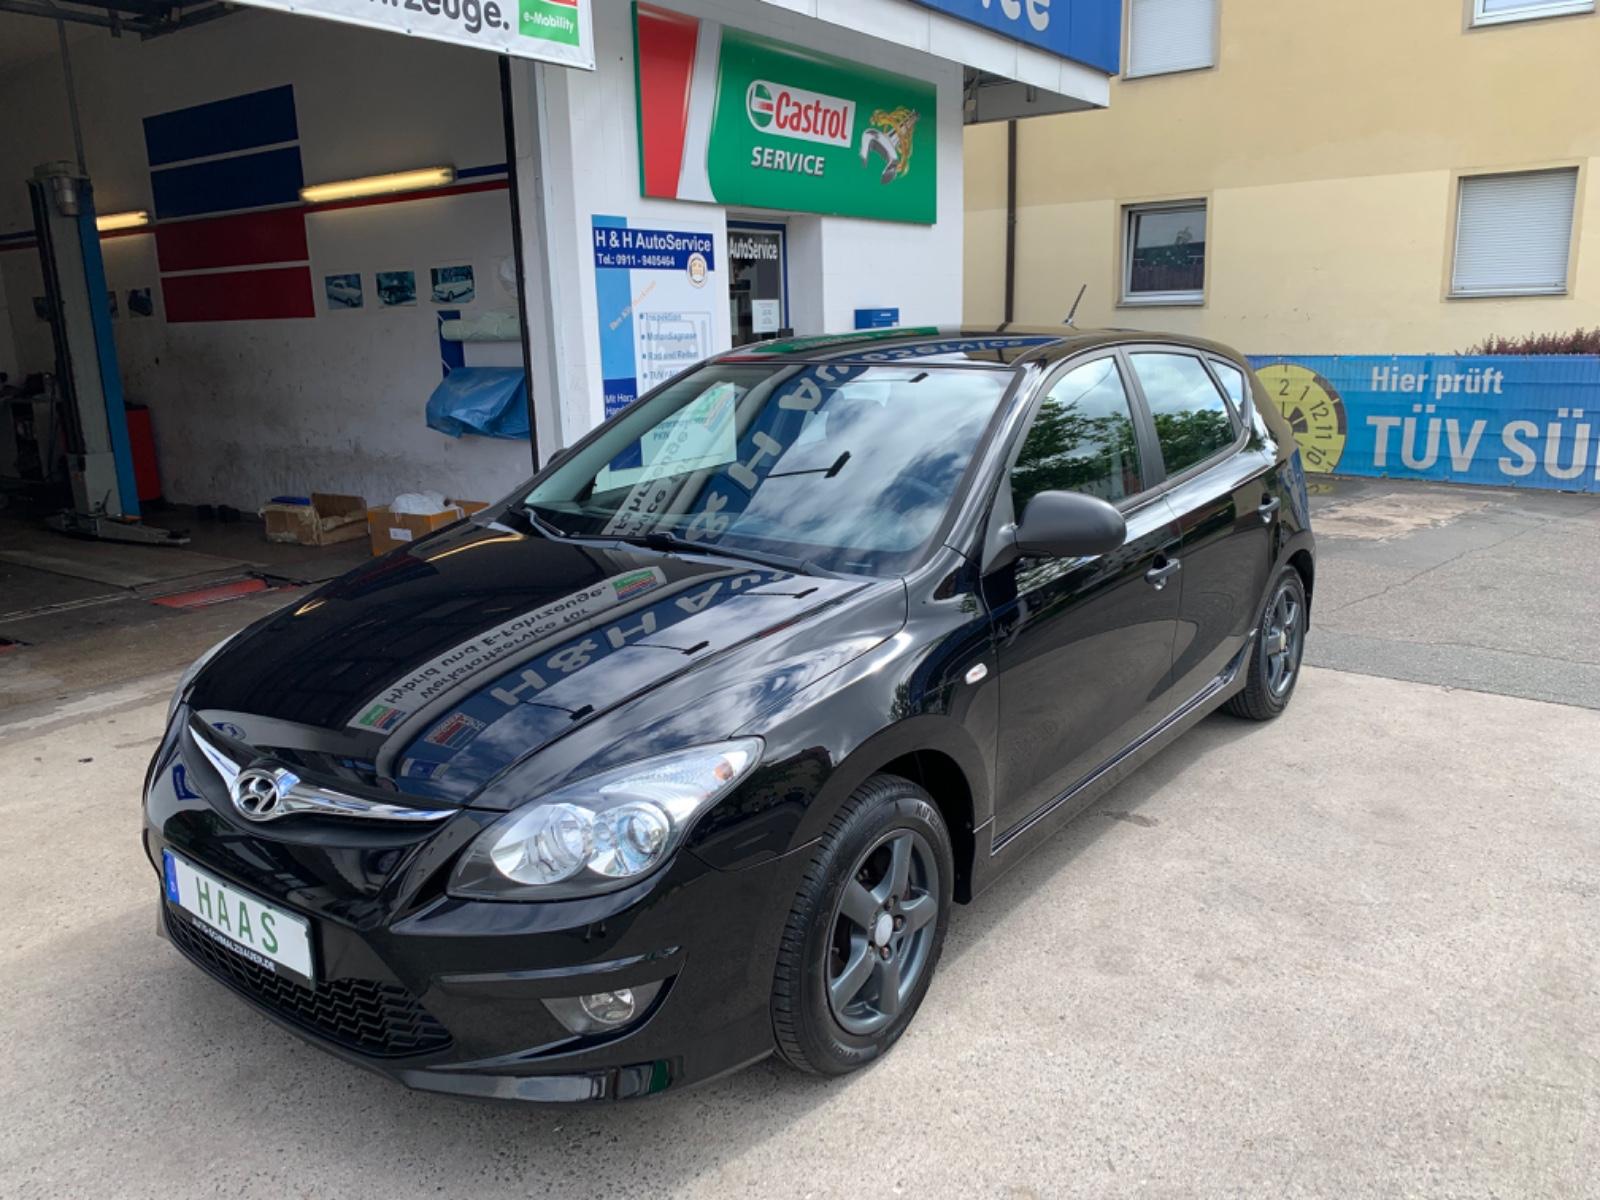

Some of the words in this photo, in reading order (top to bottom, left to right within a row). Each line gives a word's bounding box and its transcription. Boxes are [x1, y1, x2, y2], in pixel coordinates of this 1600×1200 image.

[523, 11, 574, 34] e-Mobility
[775, 91, 849, 141] Castrol
[751, 146, 825, 176] SERVICE
[595, 230, 606, 248] H
[609, 232, 620, 249] &
[622, 233, 633, 249] H
[635, 233, 712, 252] AutoService
[729, 238, 778, 260] AutoService
[617, 254, 636, 266] 0911
[1280, 379, 1289, 396] 2
[1300, 385, 1310, 401] 1
[1371, 366, 1429, 393] Hier
[1436, 366, 1504, 399] prüft
[1310, 400, 1329, 421] 12
[1315, 425, 1332, 439] 11
[1366, 404, 1487, 472] TÜV
[1498, 407, 1600, 480] SÜ
[1306, 446, 1327, 466] 10
[196, 876, 279, 954] HAAS
